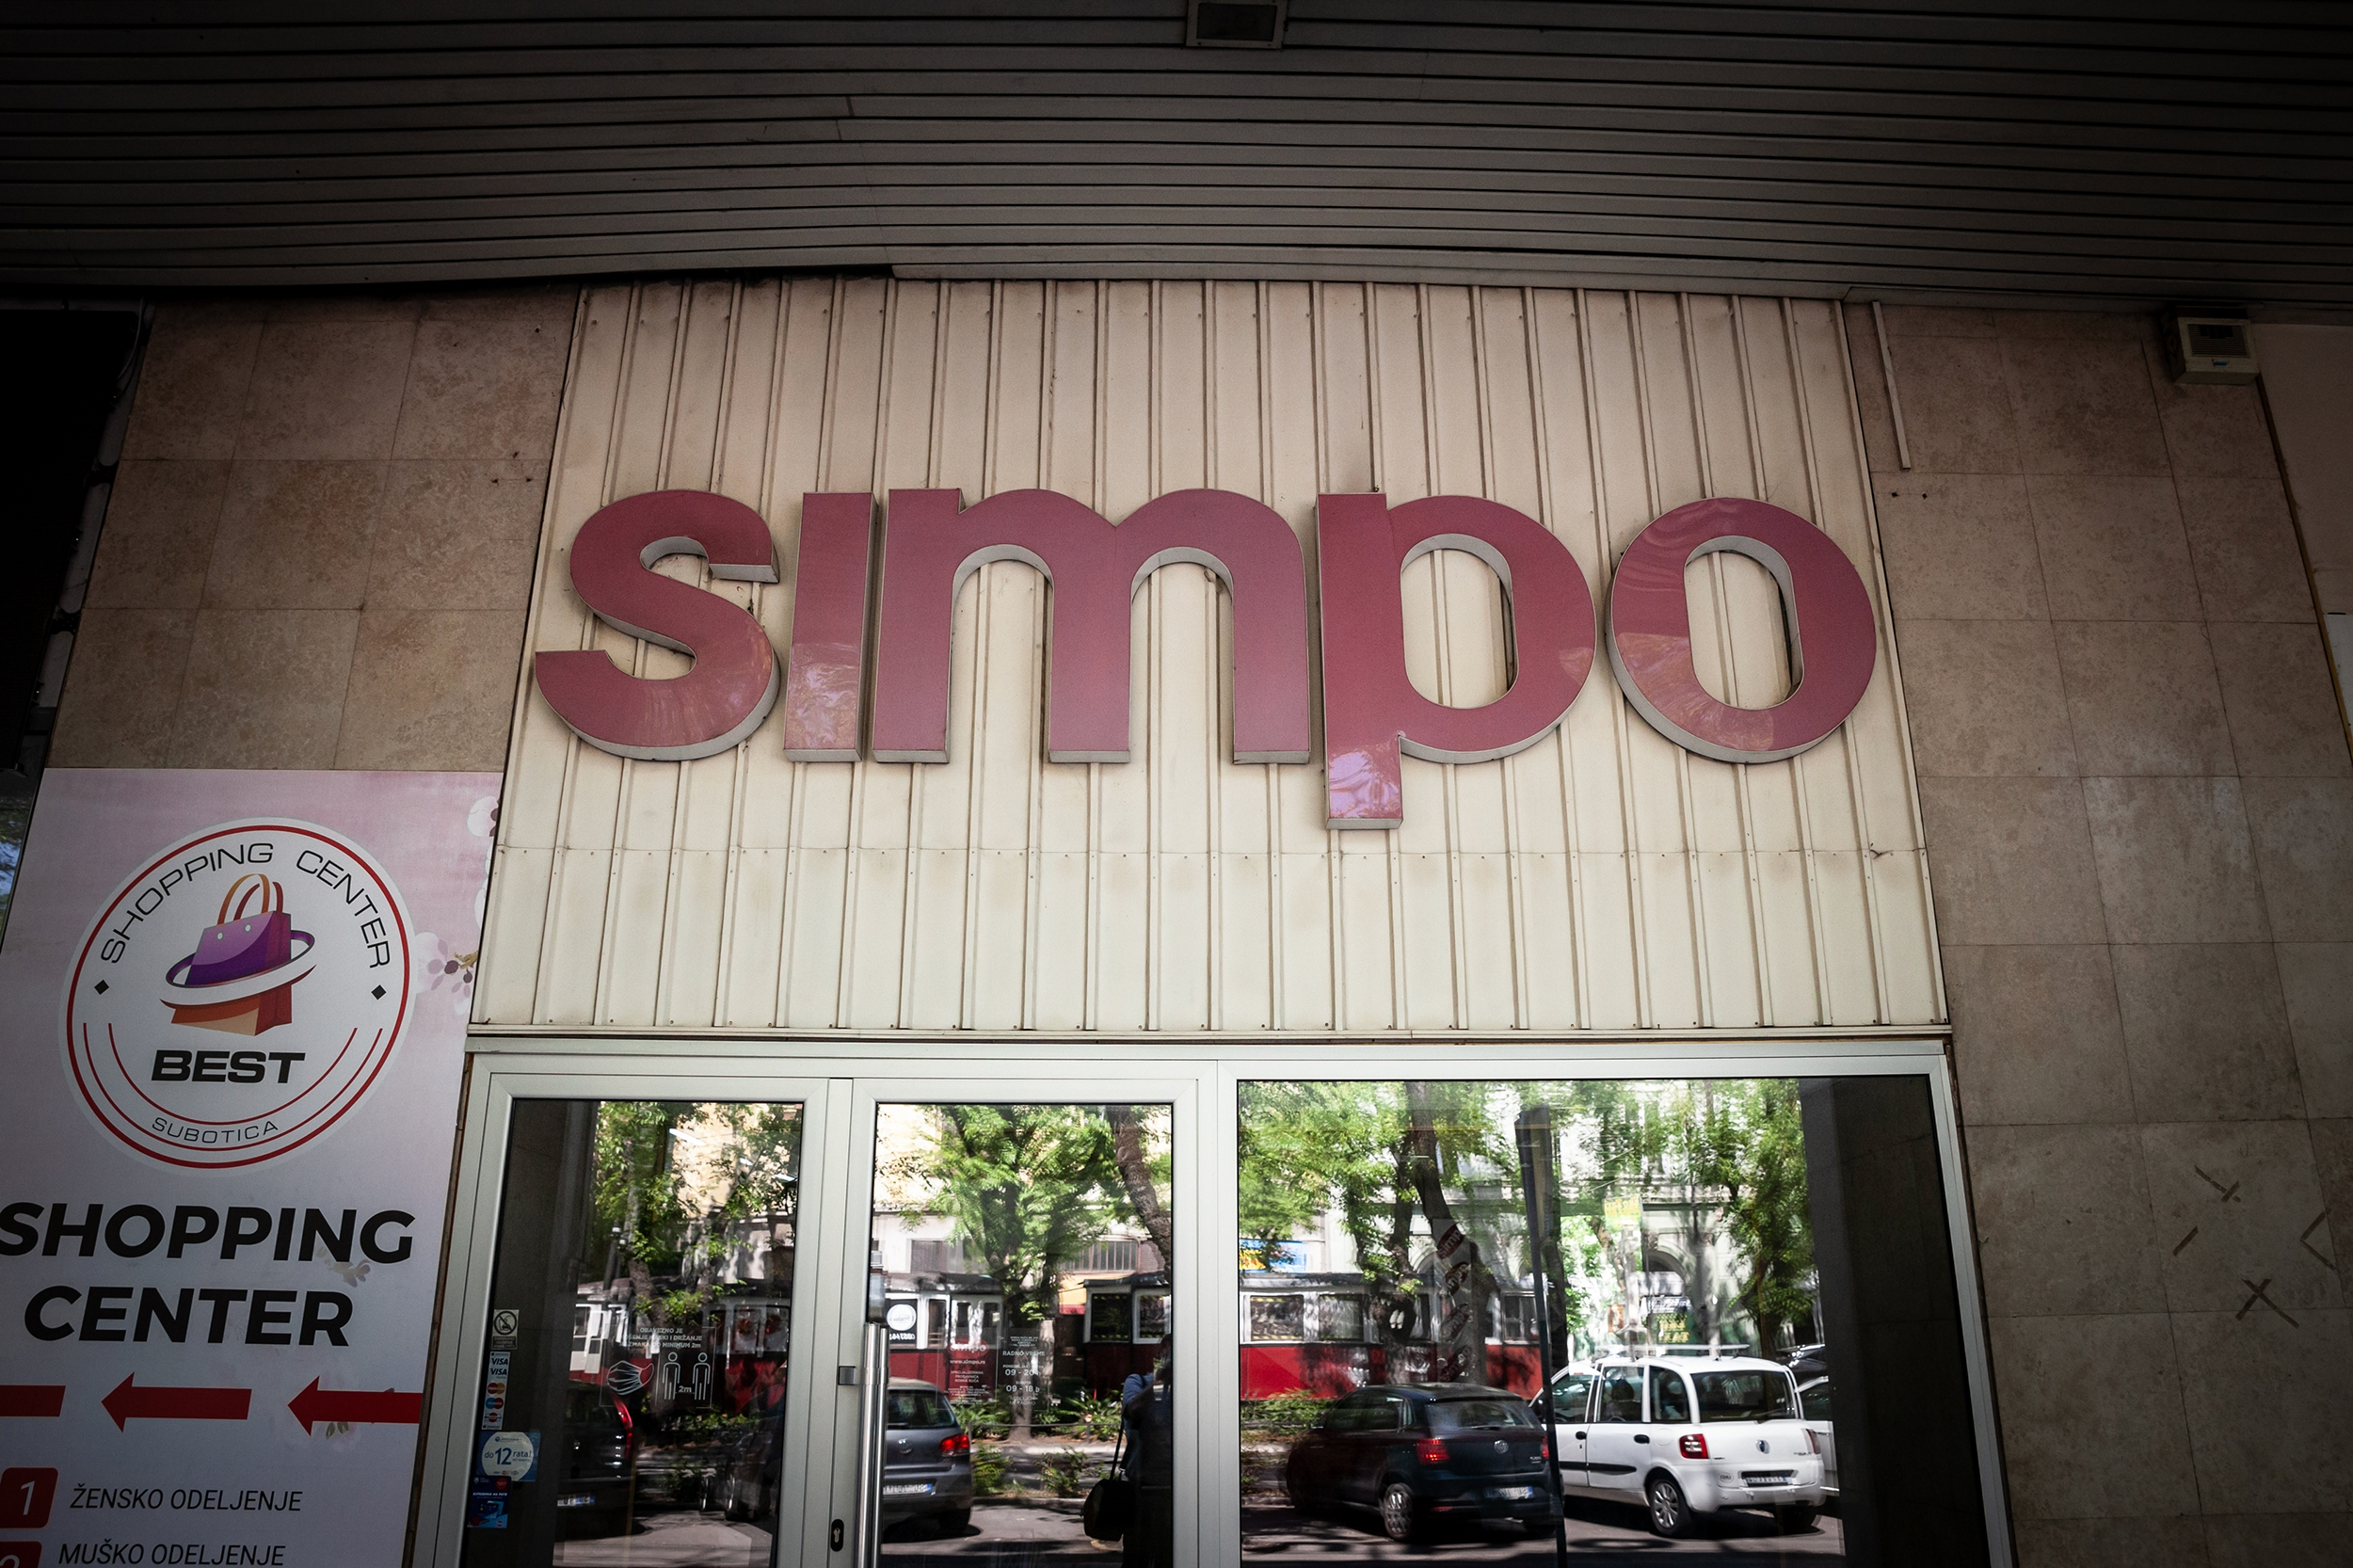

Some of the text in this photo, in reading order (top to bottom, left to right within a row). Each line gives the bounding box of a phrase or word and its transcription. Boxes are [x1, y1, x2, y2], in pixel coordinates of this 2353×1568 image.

[534, 488, 1878, 830] simpo
[101, 842, 391, 969] SHOPPING CENTER
[151, 1049, 306, 1083] BEST
[151, 1116, 279, 1144] SUBOTICA
[0, 1201, 415, 1264] SHOPPING
[24, 1285, 354, 1347] CENTER
[485, 1450, 494, 1459] do
[494, 1448, 512, 1465] 12
[19, 1480, 36, 1516] 1
[70, 1483, 303, 1512] ŽENSKO ODELJENJE
[58, 1539, 285, 1566] MUŠKO ODELJENJE
